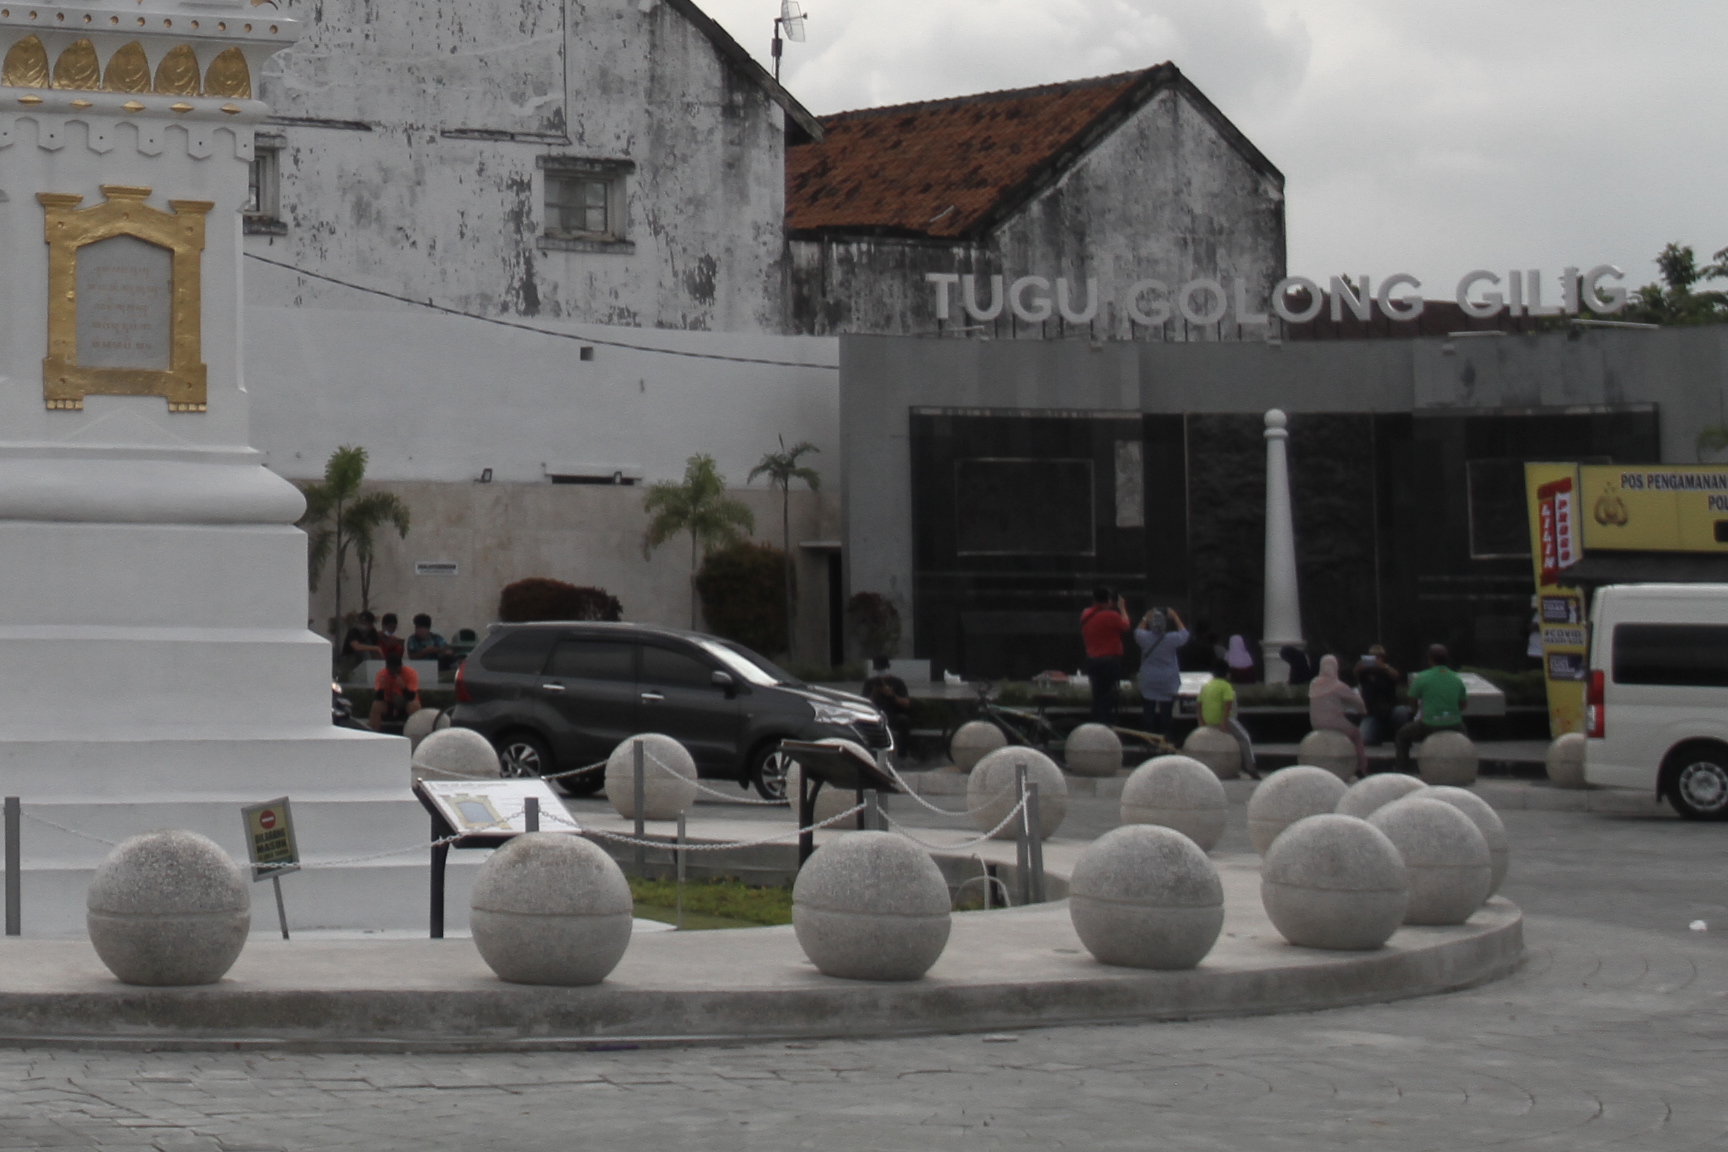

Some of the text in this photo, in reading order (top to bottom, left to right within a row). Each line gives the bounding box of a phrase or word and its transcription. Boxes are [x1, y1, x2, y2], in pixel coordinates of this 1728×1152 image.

[925, 263, 1628, 326] TUGU GOLONG GILIG
[1621, 473, 1728, 491] POS PENGAMANAN
